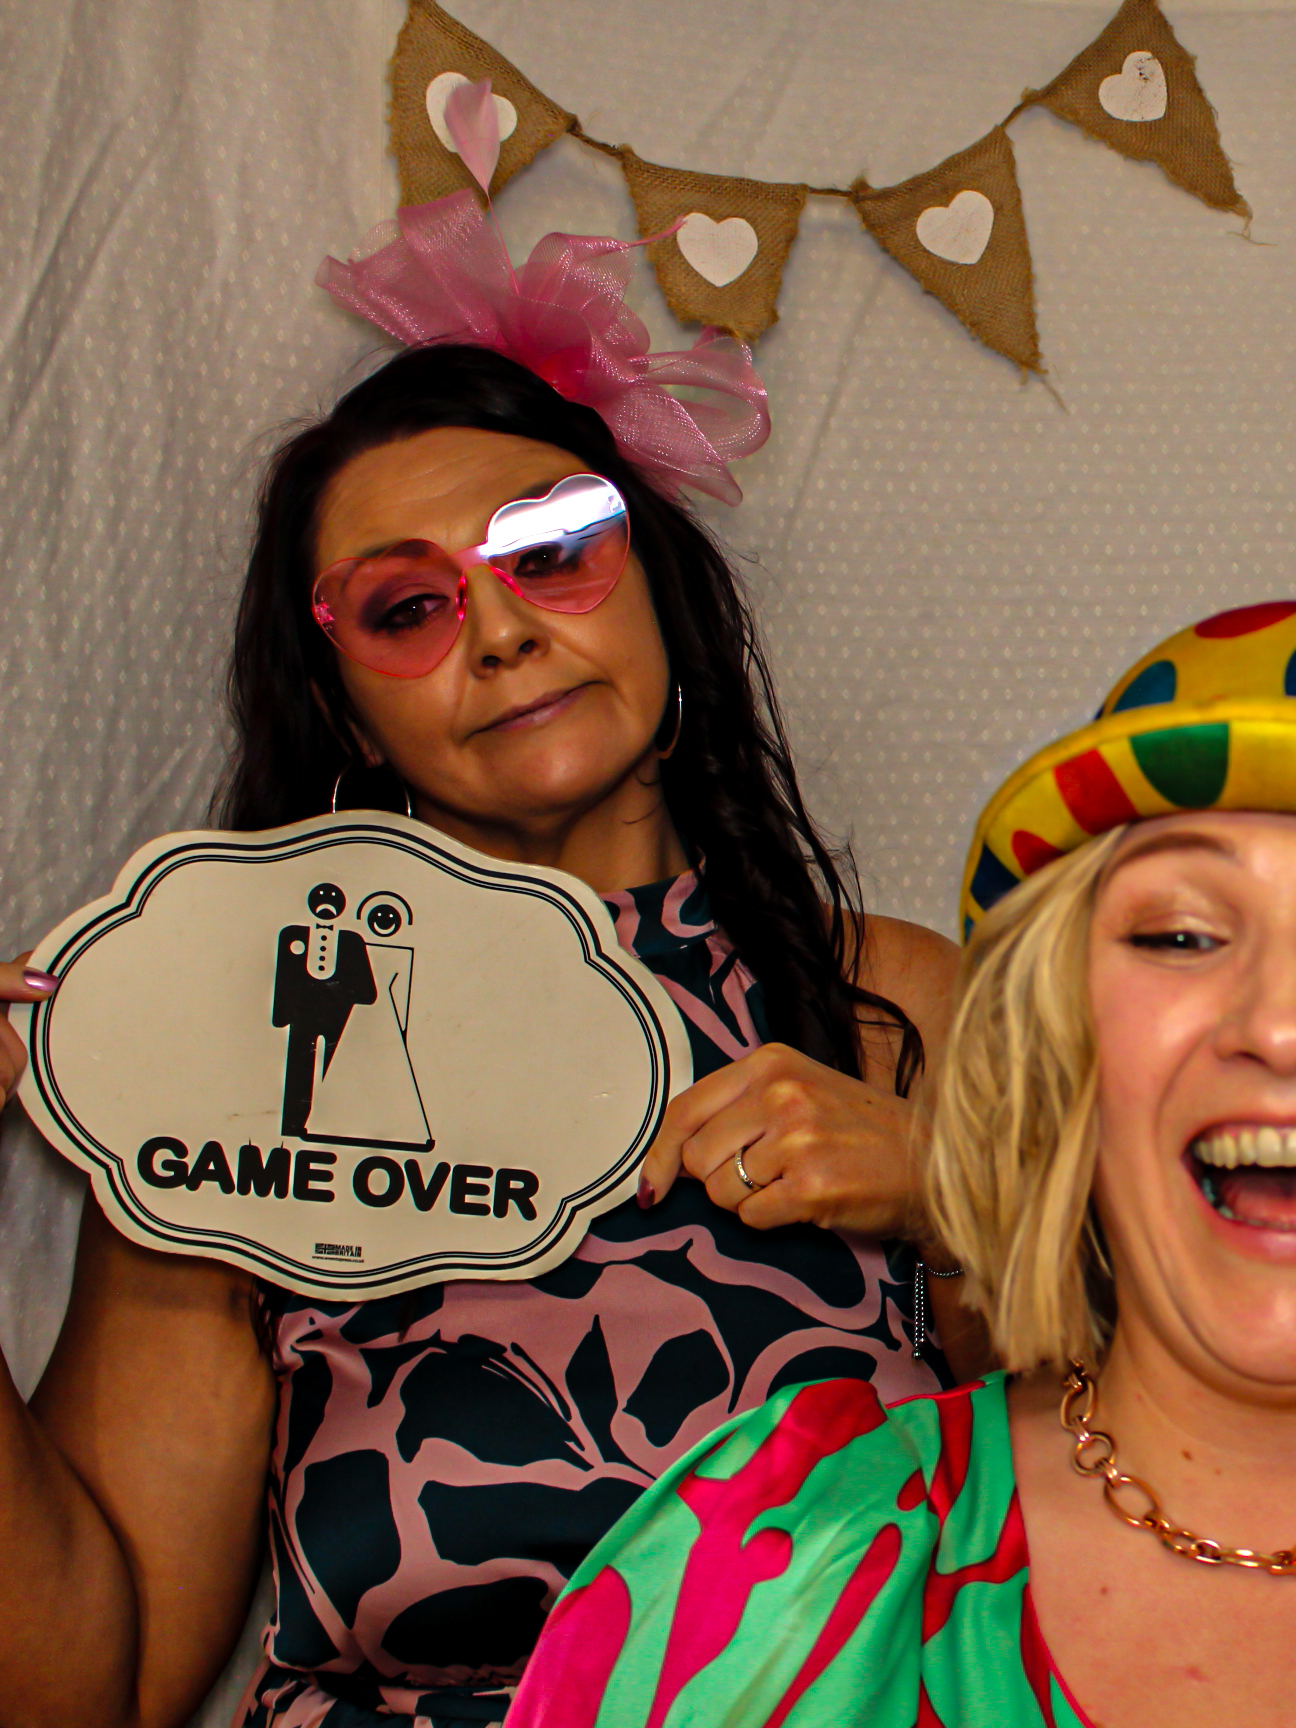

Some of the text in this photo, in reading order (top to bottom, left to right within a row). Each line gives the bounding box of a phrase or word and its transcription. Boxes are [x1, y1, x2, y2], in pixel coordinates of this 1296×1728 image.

[137, 1136, 540, 1221] GAME OVER
[335, 1244, 354, 1252] MADE
